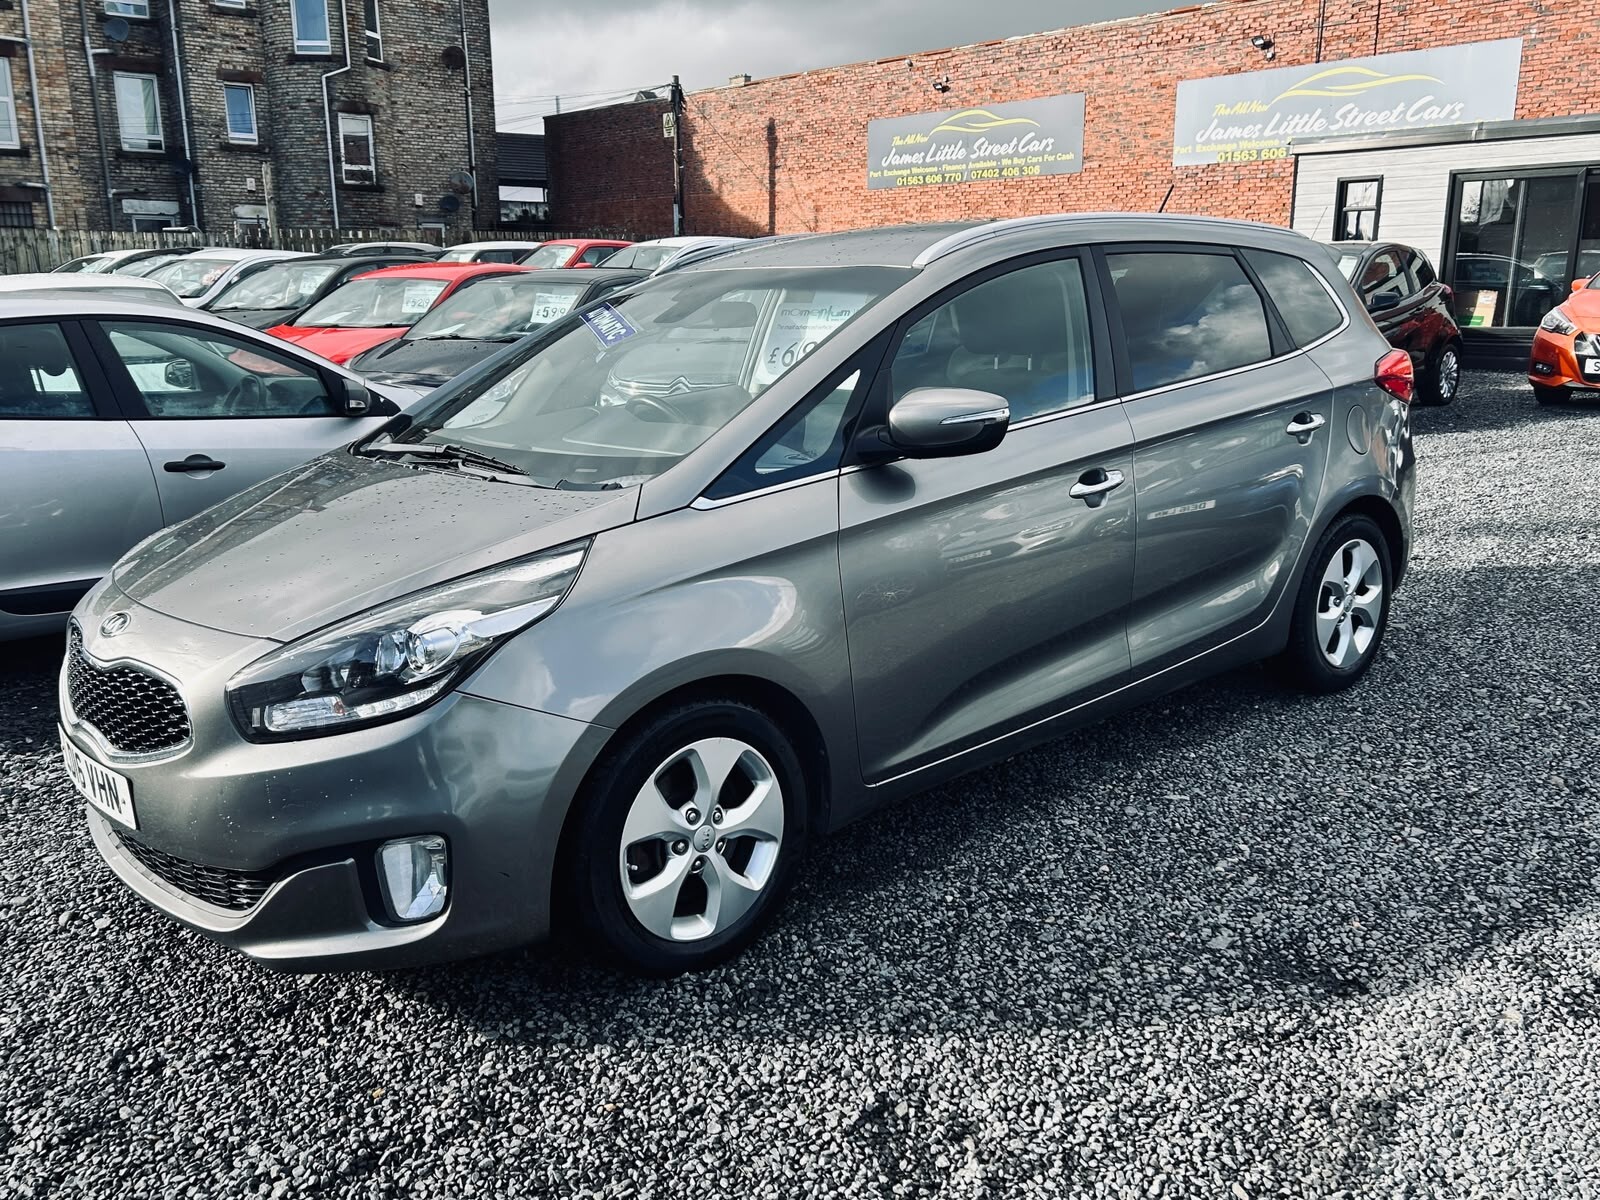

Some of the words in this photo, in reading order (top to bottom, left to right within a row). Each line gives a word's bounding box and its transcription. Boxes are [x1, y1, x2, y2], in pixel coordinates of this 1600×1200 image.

[1212, 103, 1231, 117] The
[1231, 101, 1250, 115] All
[1249, 100, 1268, 113] New
[1195, 118, 1262, 142] James
[1263, 108, 1328, 137] Little
[1328, 102, 1405, 131] Street
[1405, 95, 1465, 123] Cars
[881, 147, 925, 167] James
[925, 140, 967, 163] Little
[970, 136, 1018, 159] Street
[1018, 131, 1055, 154] Cars
[891, 136, 904, 147] The
[903, 134, 917, 146] All
[915, 133, 929, 143] New
[1196, 142, 1237, 153] Exchange
[1239, 139, 1280, 149] Welcome
[883, 168, 911, 178] Exchange
[911, 165, 938, 174] Welcome
[942, 163, 966, 171] Finance
[968, 159, 997, 169] Available
[1001, 158, 1012, 166] We
[1013, 157, 1026, 166] Buy
[1026, 155, 1043, 164] Cars
[1043, 154, 1056, 162] For
[1056, 151, 1075, 161] Cash
[1217, 149, 1258, 163] 01563
[1261, 147, 1287, 159] 606
[896, 177, 924, 186] 01563
[925, 174, 943, 184] 606
[944, 172, 962, 182] 770
[970, 168, 999, 179] 07402
[1001, 167, 1020, 177] 406
[1022, 165, 1041, 176] 306
[781, 305, 851, 321] momentum
[85, 760, 122, 814] VHN
